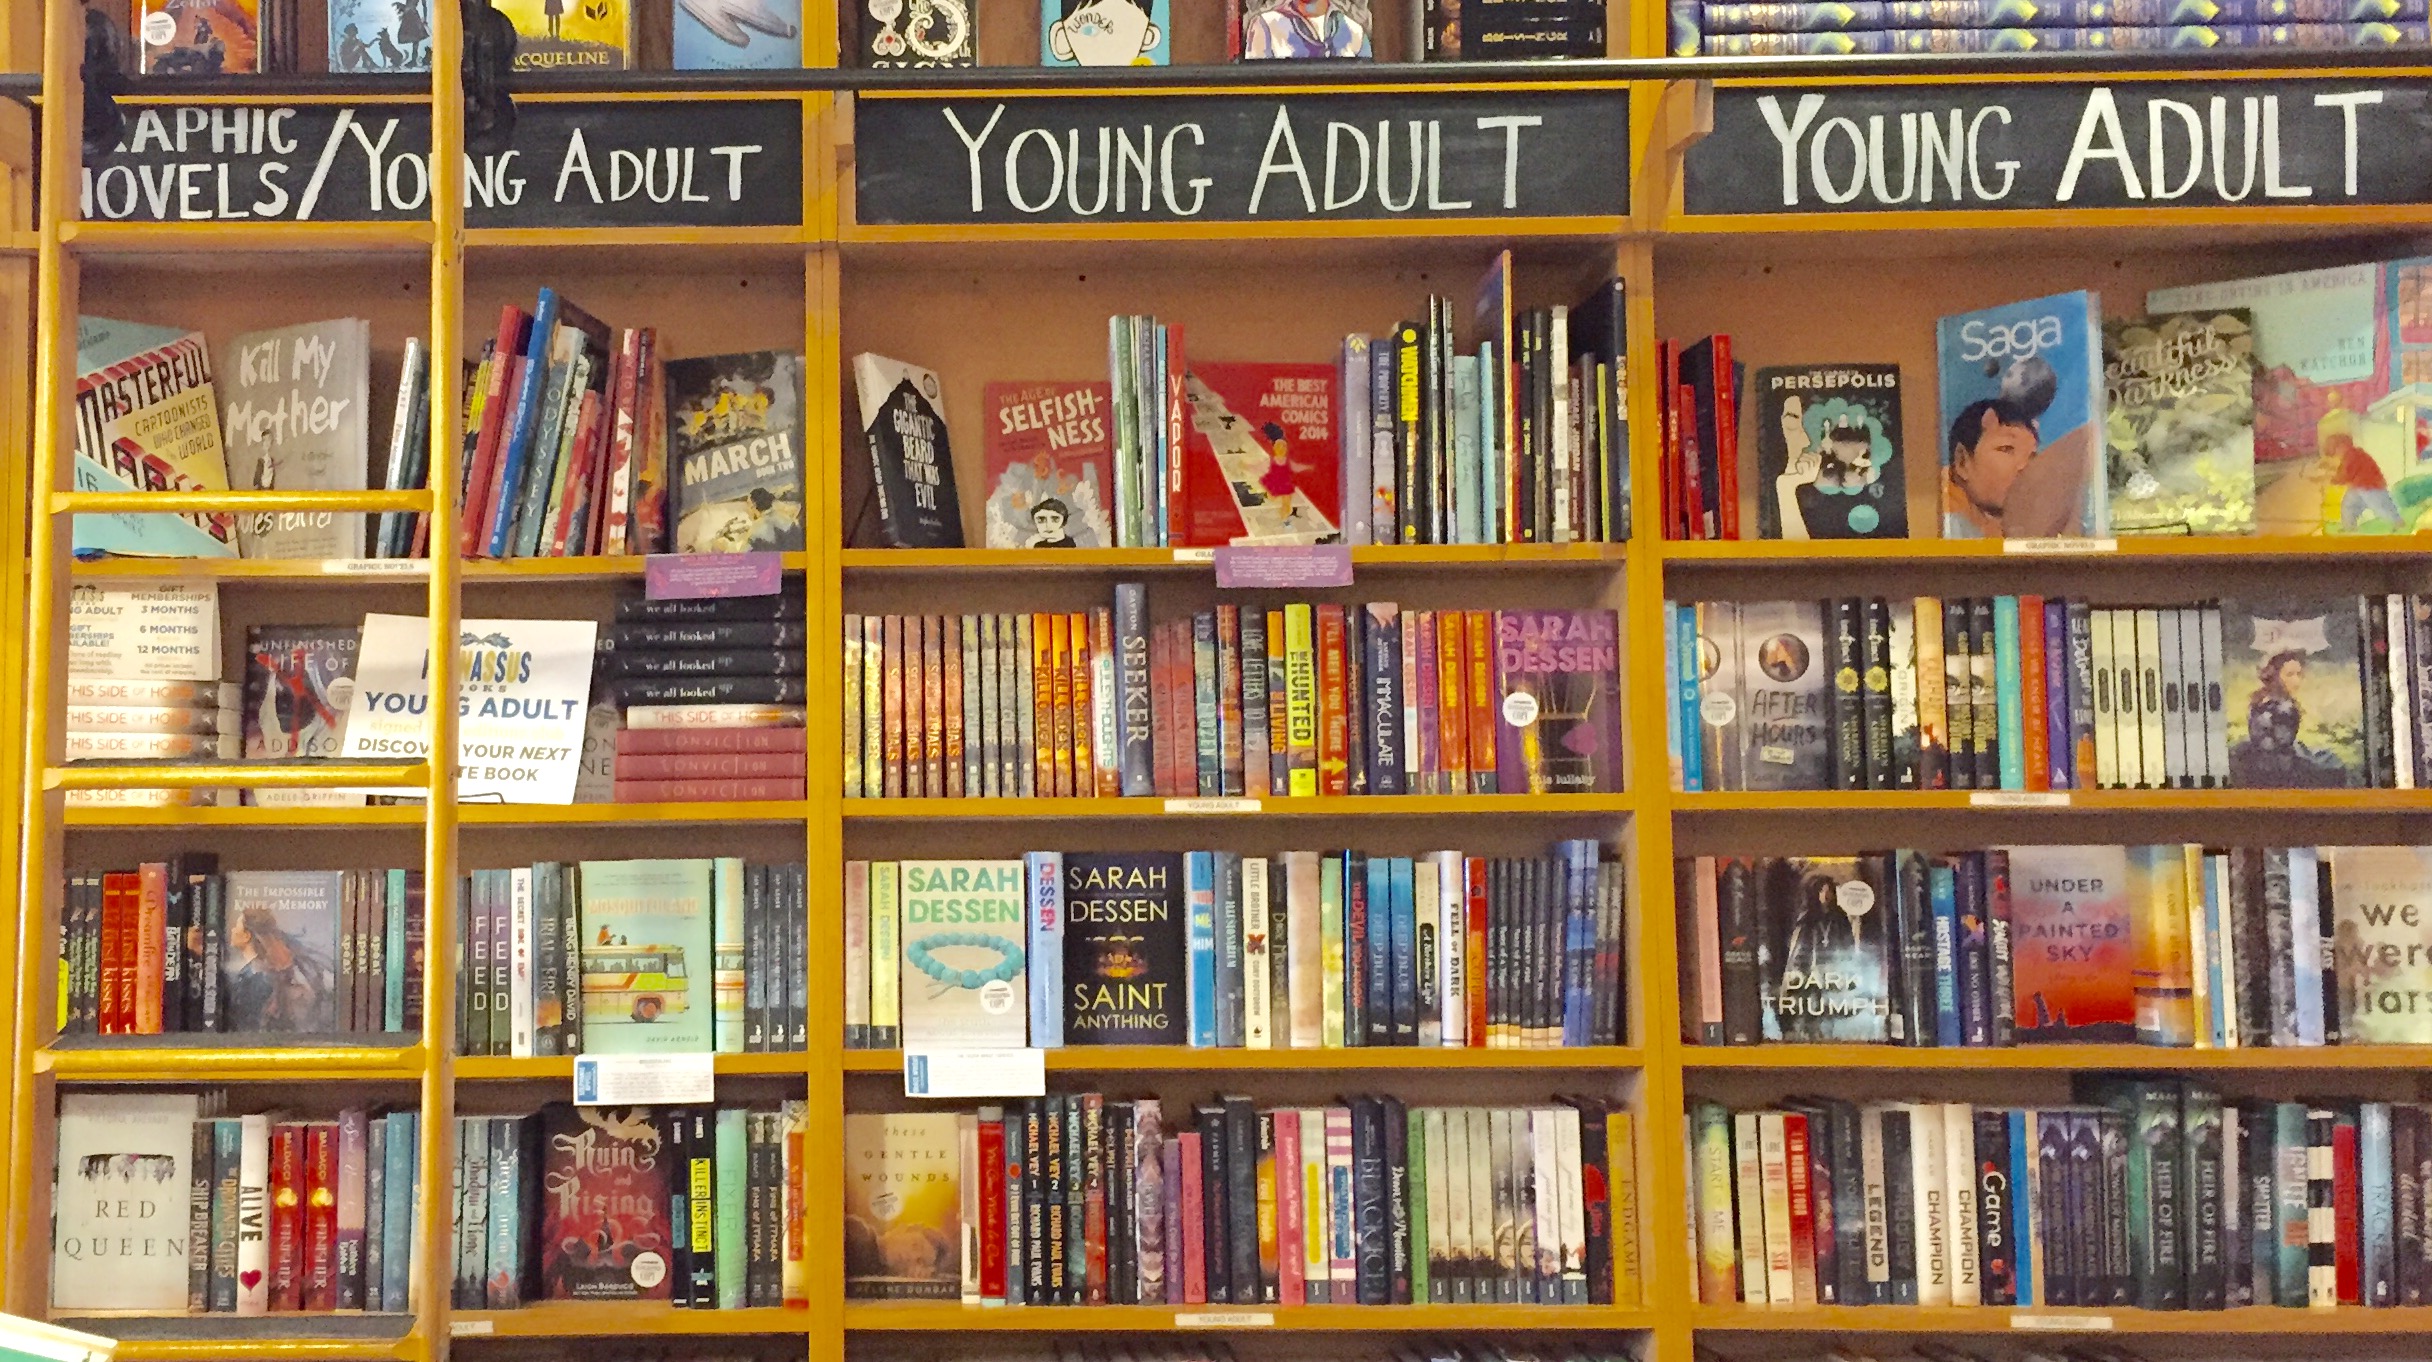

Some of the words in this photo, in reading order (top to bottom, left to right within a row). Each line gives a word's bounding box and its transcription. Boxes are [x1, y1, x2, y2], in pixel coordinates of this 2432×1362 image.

[942, 103, 1213, 216] YOUNG
[1248, 104, 1543, 215] ADULT
[1756, 93, 2021, 206] YOUNG
[2055, 87, 2383, 202] ADULT
[555, 128, 762, 204] ADULT
[1961, 314, 2062, 363] Saga
[240, 338, 281, 388] Kill
[293, 335, 336, 388] My
[1273, 379, 1295, 391] THE
[1297, 379, 1328, 392] BEST
[1400, 346, 1419, 422] WATCHMEN
[1771, 374, 1895, 391] PERSEPOLIS
[1000, 389, 1104, 435] SELFISH-
[1259, 394, 1329, 408] AMERICAN
[226, 388, 351, 448] Mother
[893, 409, 935, 441] GIGANTIC
[1281, 410, 1329, 424] COMICS
[1049, 418, 1106, 451] NESS
[1171, 375, 1183, 493] VAPOR
[1299, 425, 1329, 441] 2014
[526, 388, 561, 519] ODYSSEY
[684, 431, 793, 487] MARCH
[903, 435, 935, 466] BEARD
[915, 484, 938, 512] EVIL
[85, 606, 124, 616] ADULT
[131, 593, 212, 602] MEMBERSHIPS
[150, 606, 200, 615] MONTHS
[149, 625, 199, 635] MONTHS
[1500, 615, 1615, 643] SARAH
[151, 645, 200, 655] MONTHS
[267, 654, 315, 672] LIFE
[1504, 647, 1616, 673] DESSEN
[97, 684, 128, 698] SIDE
[1122, 634, 1149, 748] SEEKER
[1291, 660, 1312, 742] HUNTED
[1752, 688, 1819, 716] AFTER
[97, 712, 127, 725] SIDE
[478, 697, 579, 720] ADULT
[687, 711, 718, 723] SIDE
[1375, 677, 1394, 767] IMMACULATE
[664, 732, 769, 749] CONVICTION
[1199, 700, 1214, 757] FROZEN
[97, 738, 128, 751] SIDE
[463, 743, 515, 759] YOUR
[519, 746, 572, 761] NEXT
[484, 766, 540, 782] BOOK
[662, 756, 768, 774] CONVICTION
[659, 780, 767, 799] CONVICTION
[235, 885, 261, 898] THE
[263, 885, 326, 898] IMPOSSIBLE
[908, 866, 1019, 893] SARAH
[1069, 866, 1167, 892] SARAH
[2031, 878, 2105, 895] UNDER
[278, 899, 329, 912] MEMORY
[909, 898, 1020, 924] DESSEN
[1039, 862, 1056, 932] DESSEN
[1070, 899, 1169, 923] DESSEN
[1250, 893, 1261, 930] BROTHER
[1352, 900, 1367, 942] DEVIL
[1449, 902, 1460, 937] FELL
[2360, 902, 2421, 928] we
[565, 917, 578, 950] BEING
[1935, 915, 1951, 972] HOSTAGE
[2017, 923, 2119, 940] PAINTED
[342, 934, 353, 976] speak
[356, 933, 368, 976] speak
[371, 934, 382, 978] speak
[473, 914, 488, 1012] FEED
[494, 915, 510, 1012] FEED
[566, 951, 578, 986] HENRY
[2046, 945, 2093, 963] SKY
[1450, 956, 1461, 998] DARK
[1785, 970, 1863, 992] DARK
[567, 988, 578, 1022] DAVID
[1074, 983, 1168, 1012] SAINT
[1761, 995, 1890, 1017] TRIUMPH
[1073, 1013, 1169, 1030] ANYTHING
[1028, 1113, 1040, 1155] MICHAEL
[1048, 1112, 1060, 1157] MICHAEL
[1068, 1112, 1080, 1157] MICHAEL
[1086, 1108, 1099, 1154] MICHAEL
[553, 1128, 656, 1176] Ruin
[865, 1149, 948, 1160] GENTLE
[1028, 1155, 1041, 1177] VEY
[1087, 1154, 1100, 1177] VEY
[695, 1158, 707, 1199] KILLER
[862, 1173, 951, 1183] WOUNDS
[1048, 1158, 1061, 1181] VEY
[1051, 1180, 1059, 1190] 2
[2156, 1160, 2172, 1201] HEIR
[2200, 1160, 2215, 1200] HEIR
[95, 1200, 156, 1219] RED
[190, 1179, 211, 1210] SHIP
[545, 1170, 656, 1223] Rising
[721, 1168, 738, 1233] FIXER
[1983, 1170, 2007, 1248] Game
[240, 1185, 263, 1243] ALIVE
[696, 1200, 709, 1251] INSTINCT
[1867, 1183, 1885, 1268] LEGEND
[2157, 1203, 2174, 1226] OF
[64, 1236, 186, 1261] QUEEN
[190, 1211, 209, 1272] BREAKER
[1928, 1189, 1944, 1286] CHAMPION
[1958, 1188, 1975, 1286] CHAMPION
[2159, 1229, 2175, 1266] FIRE
